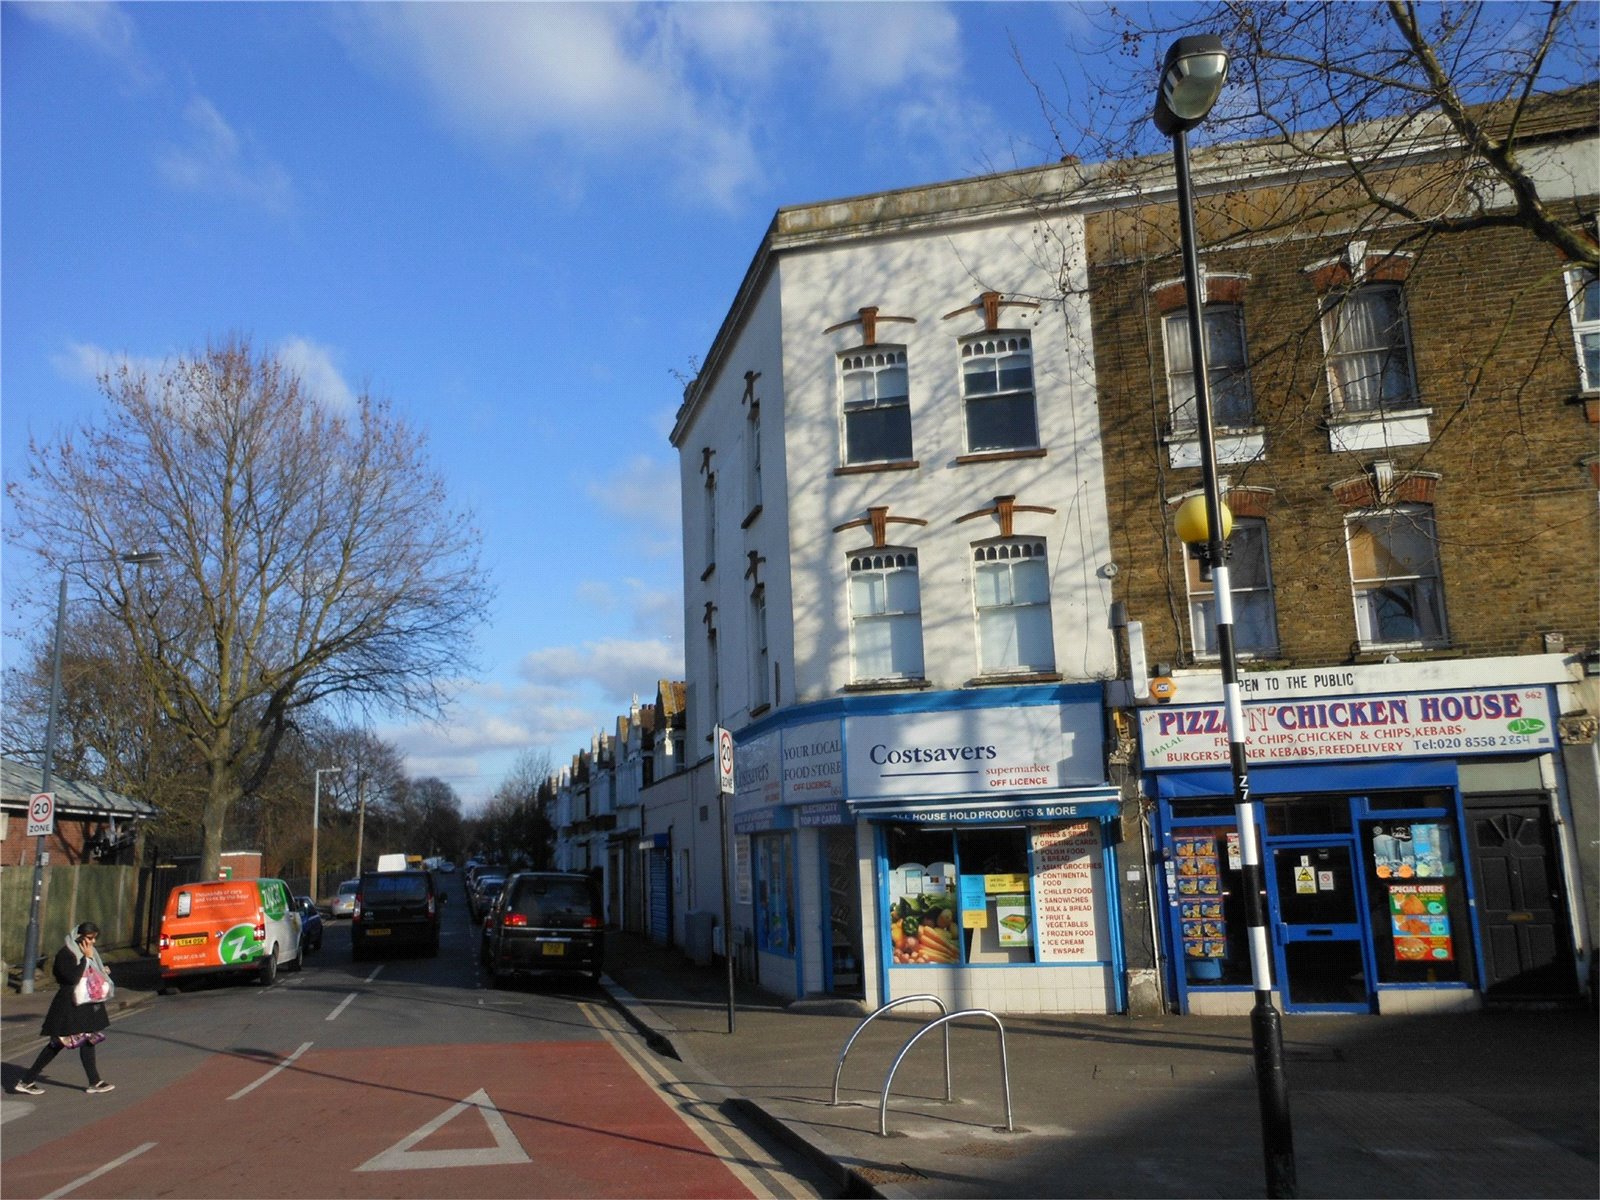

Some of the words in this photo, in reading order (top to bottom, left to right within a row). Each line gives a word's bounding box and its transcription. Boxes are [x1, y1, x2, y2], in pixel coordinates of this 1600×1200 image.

[1239, 678, 1259, 692] PEN
[1265, 677, 1280, 691] TO
[1286, 675, 1307, 689] THE
[1313, 673, 1354, 688] PUBLIC
[1525, 691, 1542, 699] 662
[1276, 699, 1409, 730] CHICKEN
[1418, 693, 1522, 722] HOUSE
[1213, 736, 1230, 747] FIS
[1244, 736, 1253, 746] &
[1360, 730, 1369, 740] &
[1465, 737, 1496, 748] 8558
[1499, 735, 1530, 746] 2854
[783, 745, 809, 760] YOUR
[811, 740, 841, 754] LOCAL
[1150, 736, 1184, 756] HALAL
[869, 744, 997, 766] Costsavers
[784, 766, 810, 781] FOOD
[811, 761, 842, 777] STORE
[985, 763, 1051, 776] supermarket
[990, 778, 1007, 787] OFF
[1009, 777, 1048, 786] LICENCE
[1239, 775, 1248, 787] Z
[1240, 789, 1249, 800] 7
[33, 803, 49, 815] 20
[912, 812, 947, 821] HOUSE
[949, 811, 977, 820] HOLD
[978, 808, 1035, 819] PRODUCTS
[1036, 807, 1044, 816] &
[1046, 806, 1077, 816] MORE
[29, 824, 50, 833] ZONE
[1063, 862, 1102, 870] GROCERIES
[1390, 885, 1417, 893] SPECIAL
[1418, 885, 1444, 893] OFFERS
